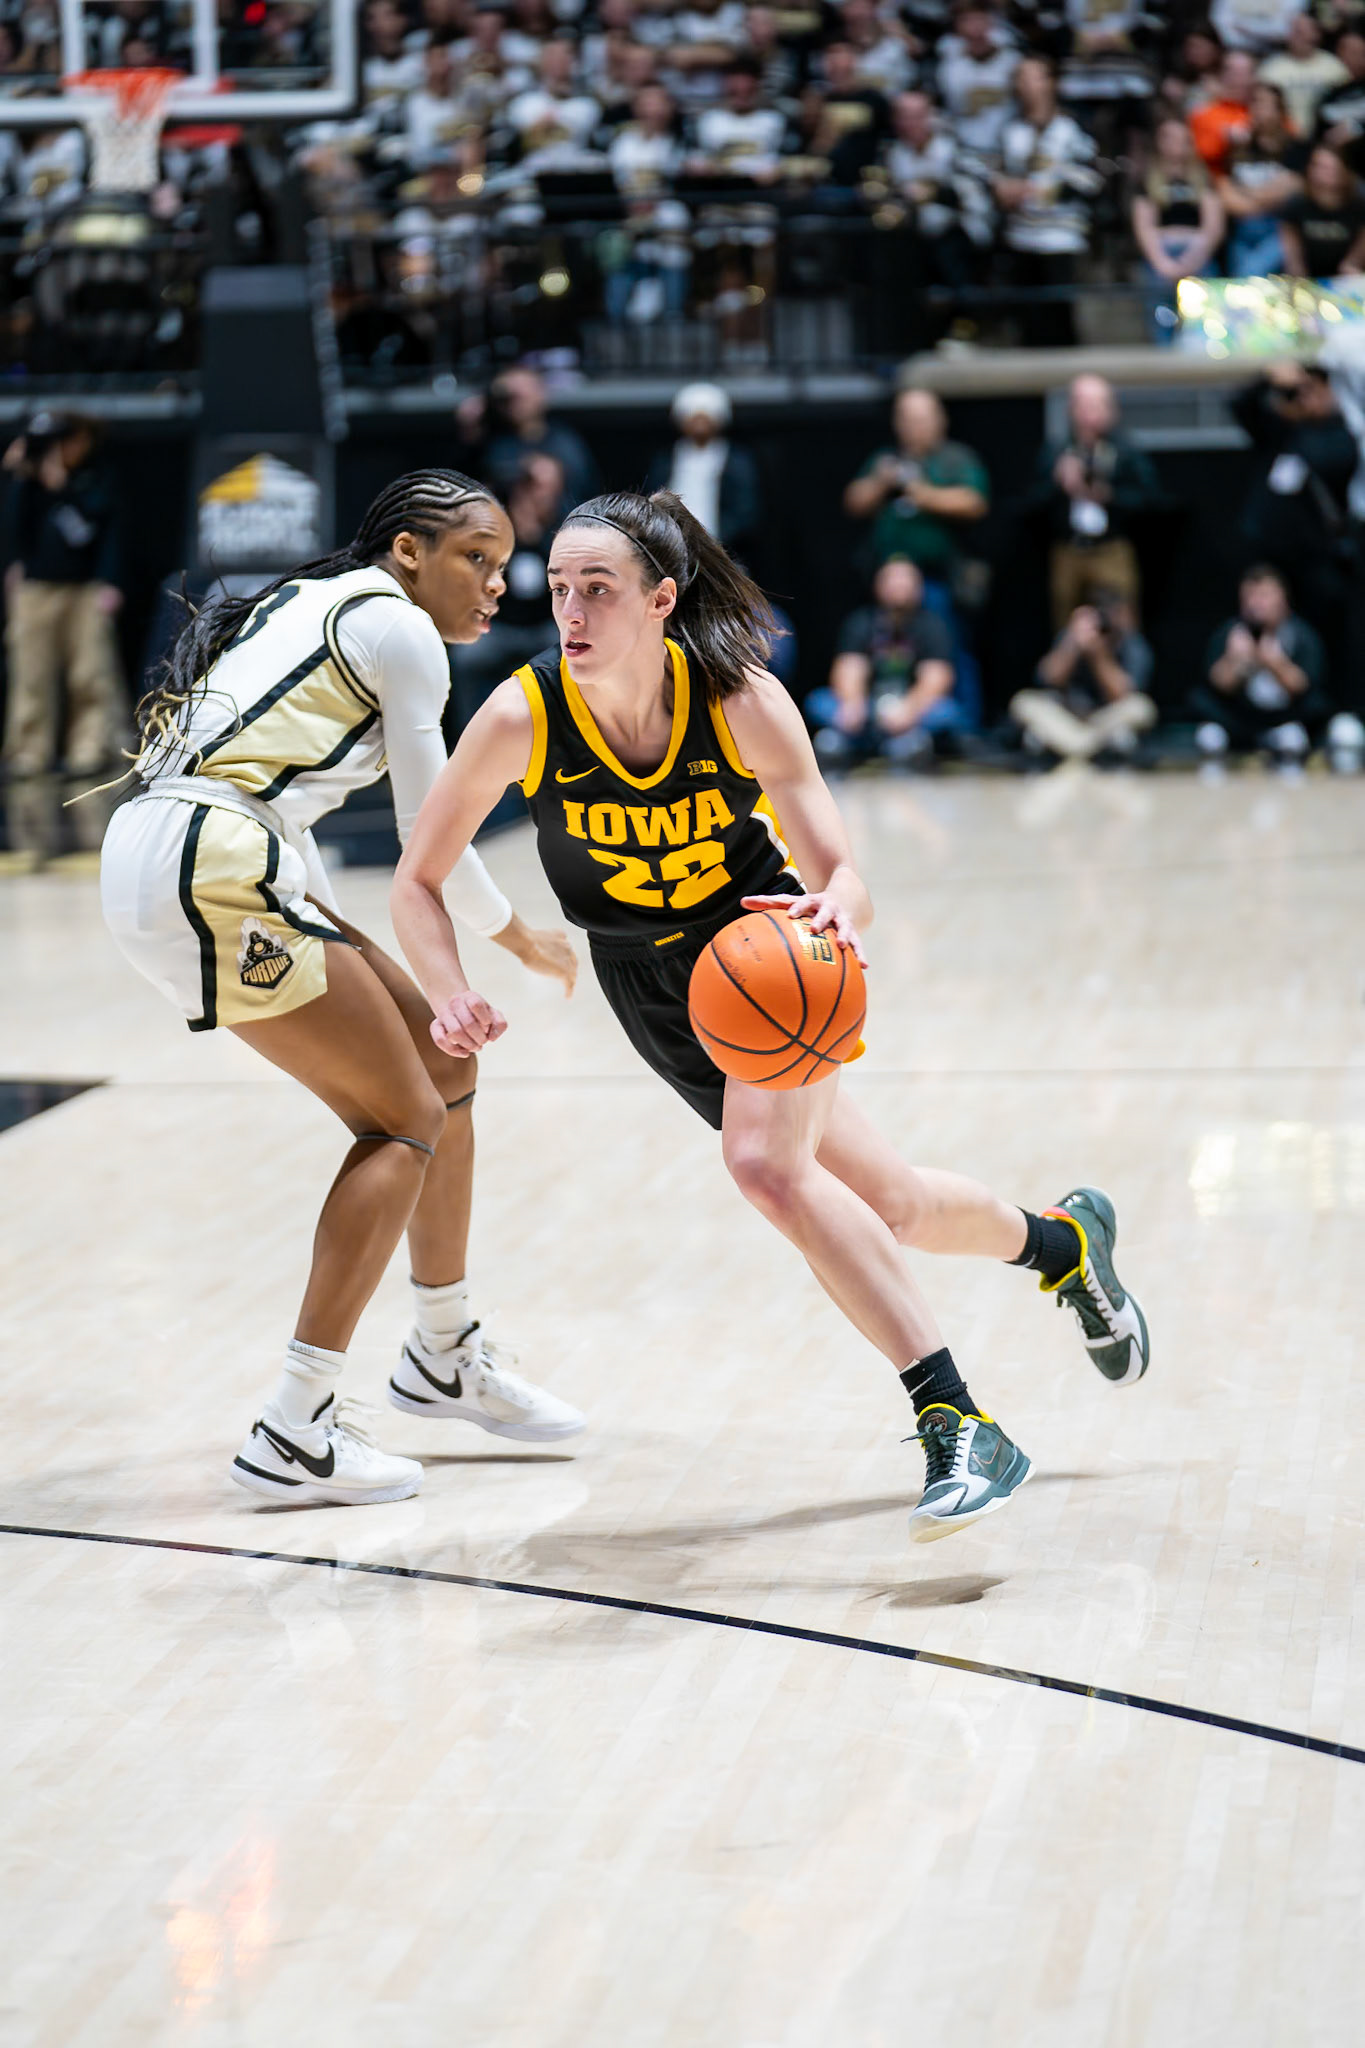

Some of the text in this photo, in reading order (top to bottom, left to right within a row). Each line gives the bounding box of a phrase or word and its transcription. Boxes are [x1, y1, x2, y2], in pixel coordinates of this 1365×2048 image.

[563, 788, 736, 846] IOWA
[587, 840, 732, 909] 22
[243, 954, 291, 983] PURDUE
